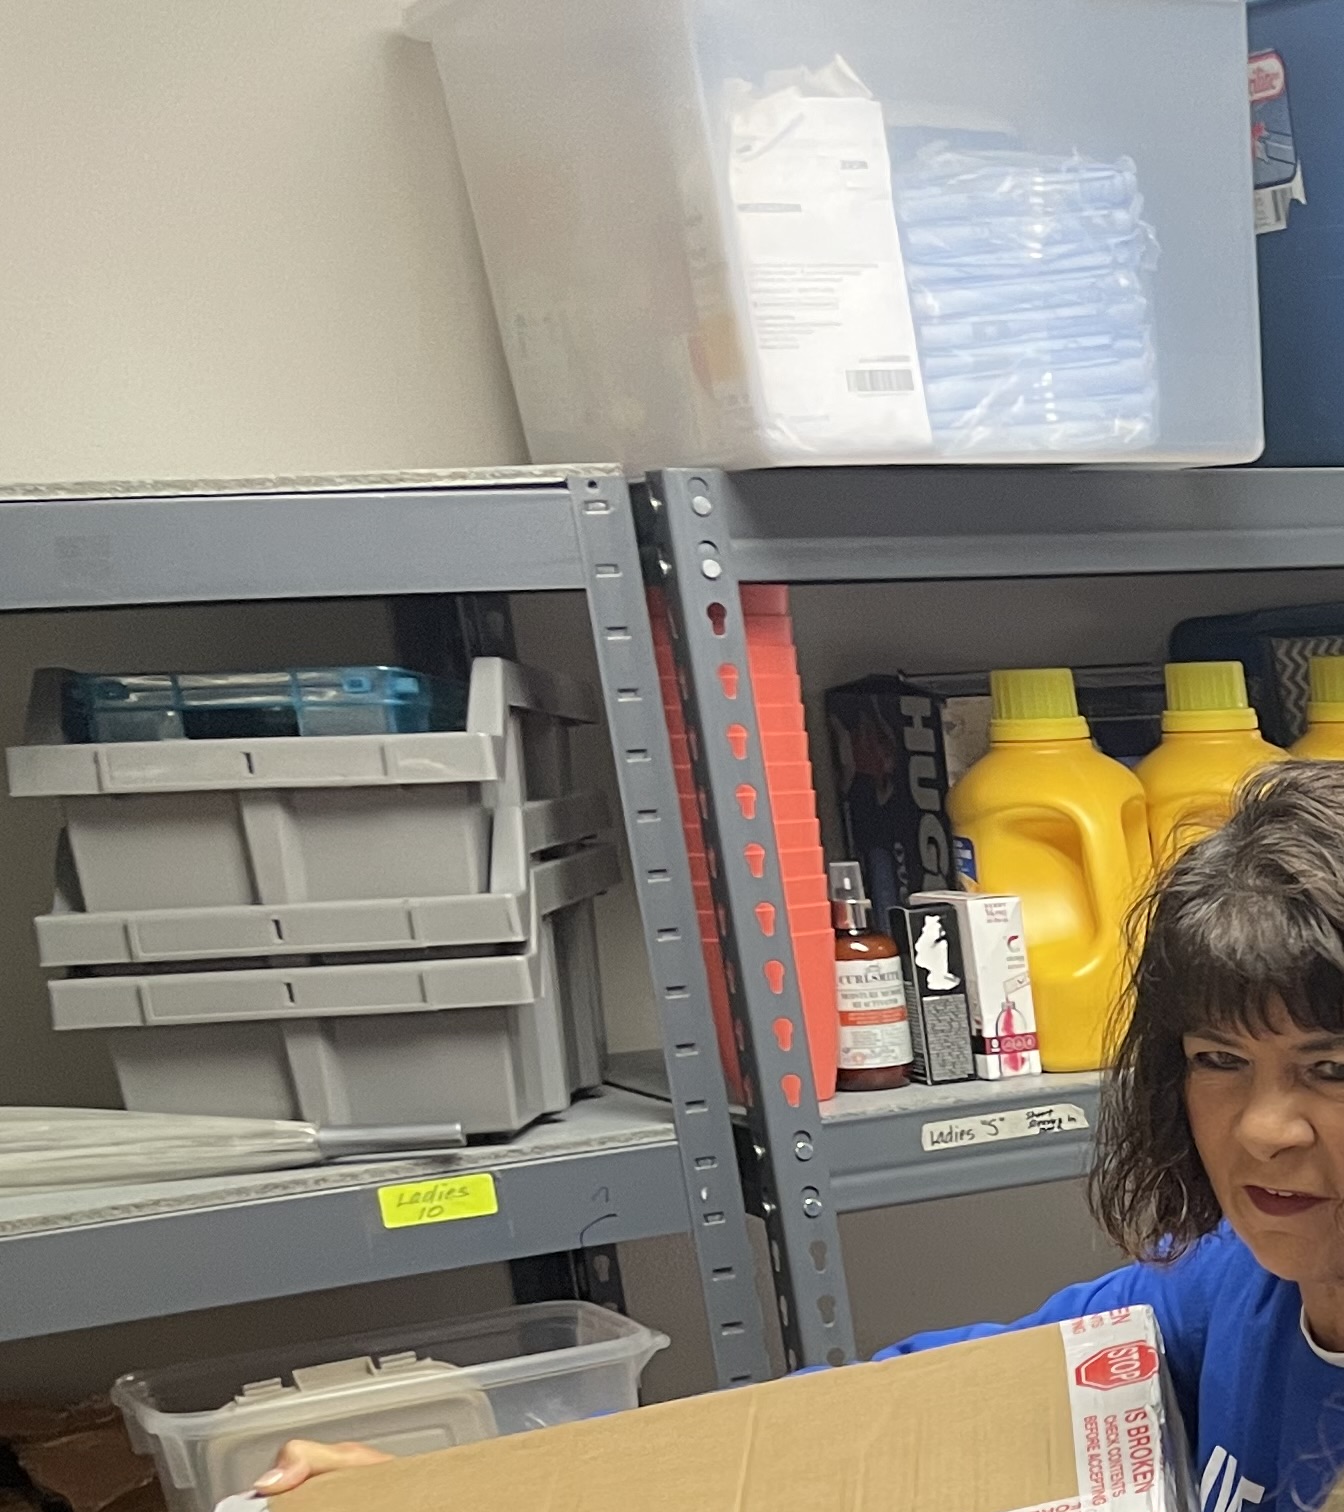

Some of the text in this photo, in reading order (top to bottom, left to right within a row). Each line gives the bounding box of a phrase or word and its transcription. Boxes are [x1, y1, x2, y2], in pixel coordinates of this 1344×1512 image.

[899, 694, 950, 892] HUG
[930, 1125, 976, 1147] Ladies
[397, 1183, 470, 1208] Ladies
[418, 1205, 444, 1221] 10
[1107, 1346, 1142, 1382] STOP
[1084, 1415, 1107, 1506] BEFORE ACCEPTING
[1104, 1414, 1126, 1498] CHECK CONTENTS
[1127, 1425, 1155, 1494] BROKEN
